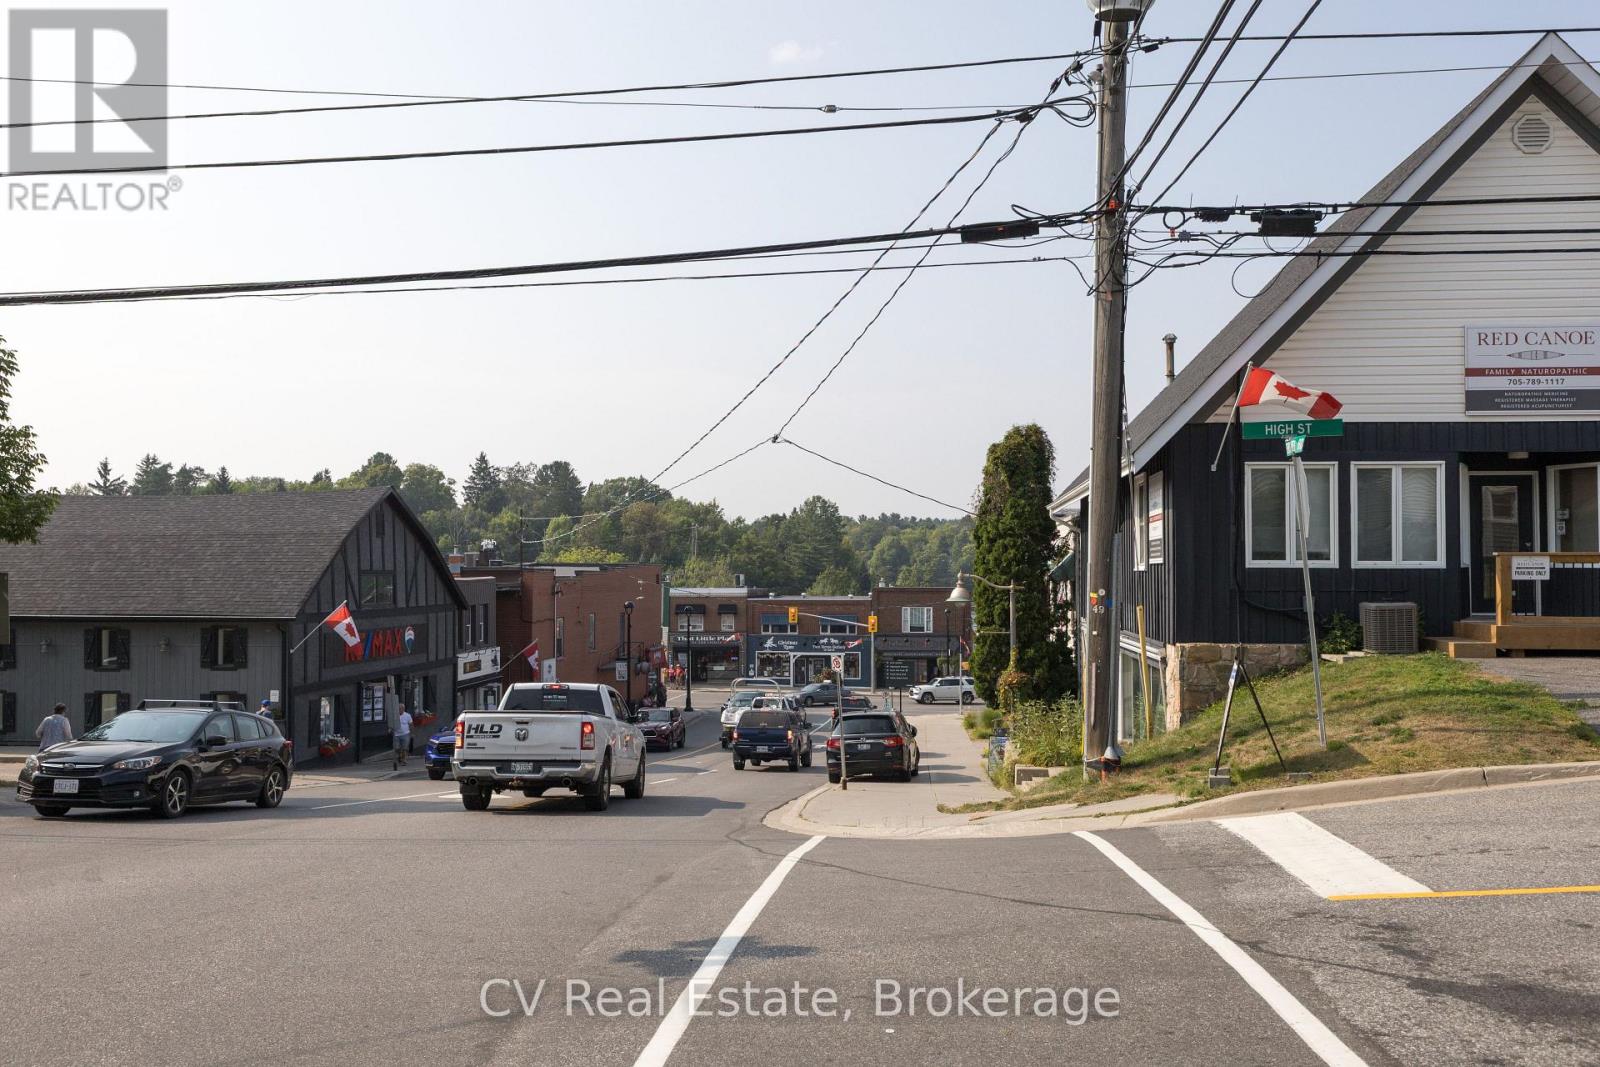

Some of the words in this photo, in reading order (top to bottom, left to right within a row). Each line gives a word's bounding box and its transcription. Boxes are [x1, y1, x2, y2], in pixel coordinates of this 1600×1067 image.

[1477, 331, 1518, 346] RED
[1525, 330, 1595, 346] CANOE
[1521, 367, 1588, 375] NATUROPATHIC
[1507, 378, 1566, 386] 705-789-1117
[1265, 424, 1293, 436] HIGH
[1297, 423, 1312, 434] ST
[466, 723, 503, 735] HLD
